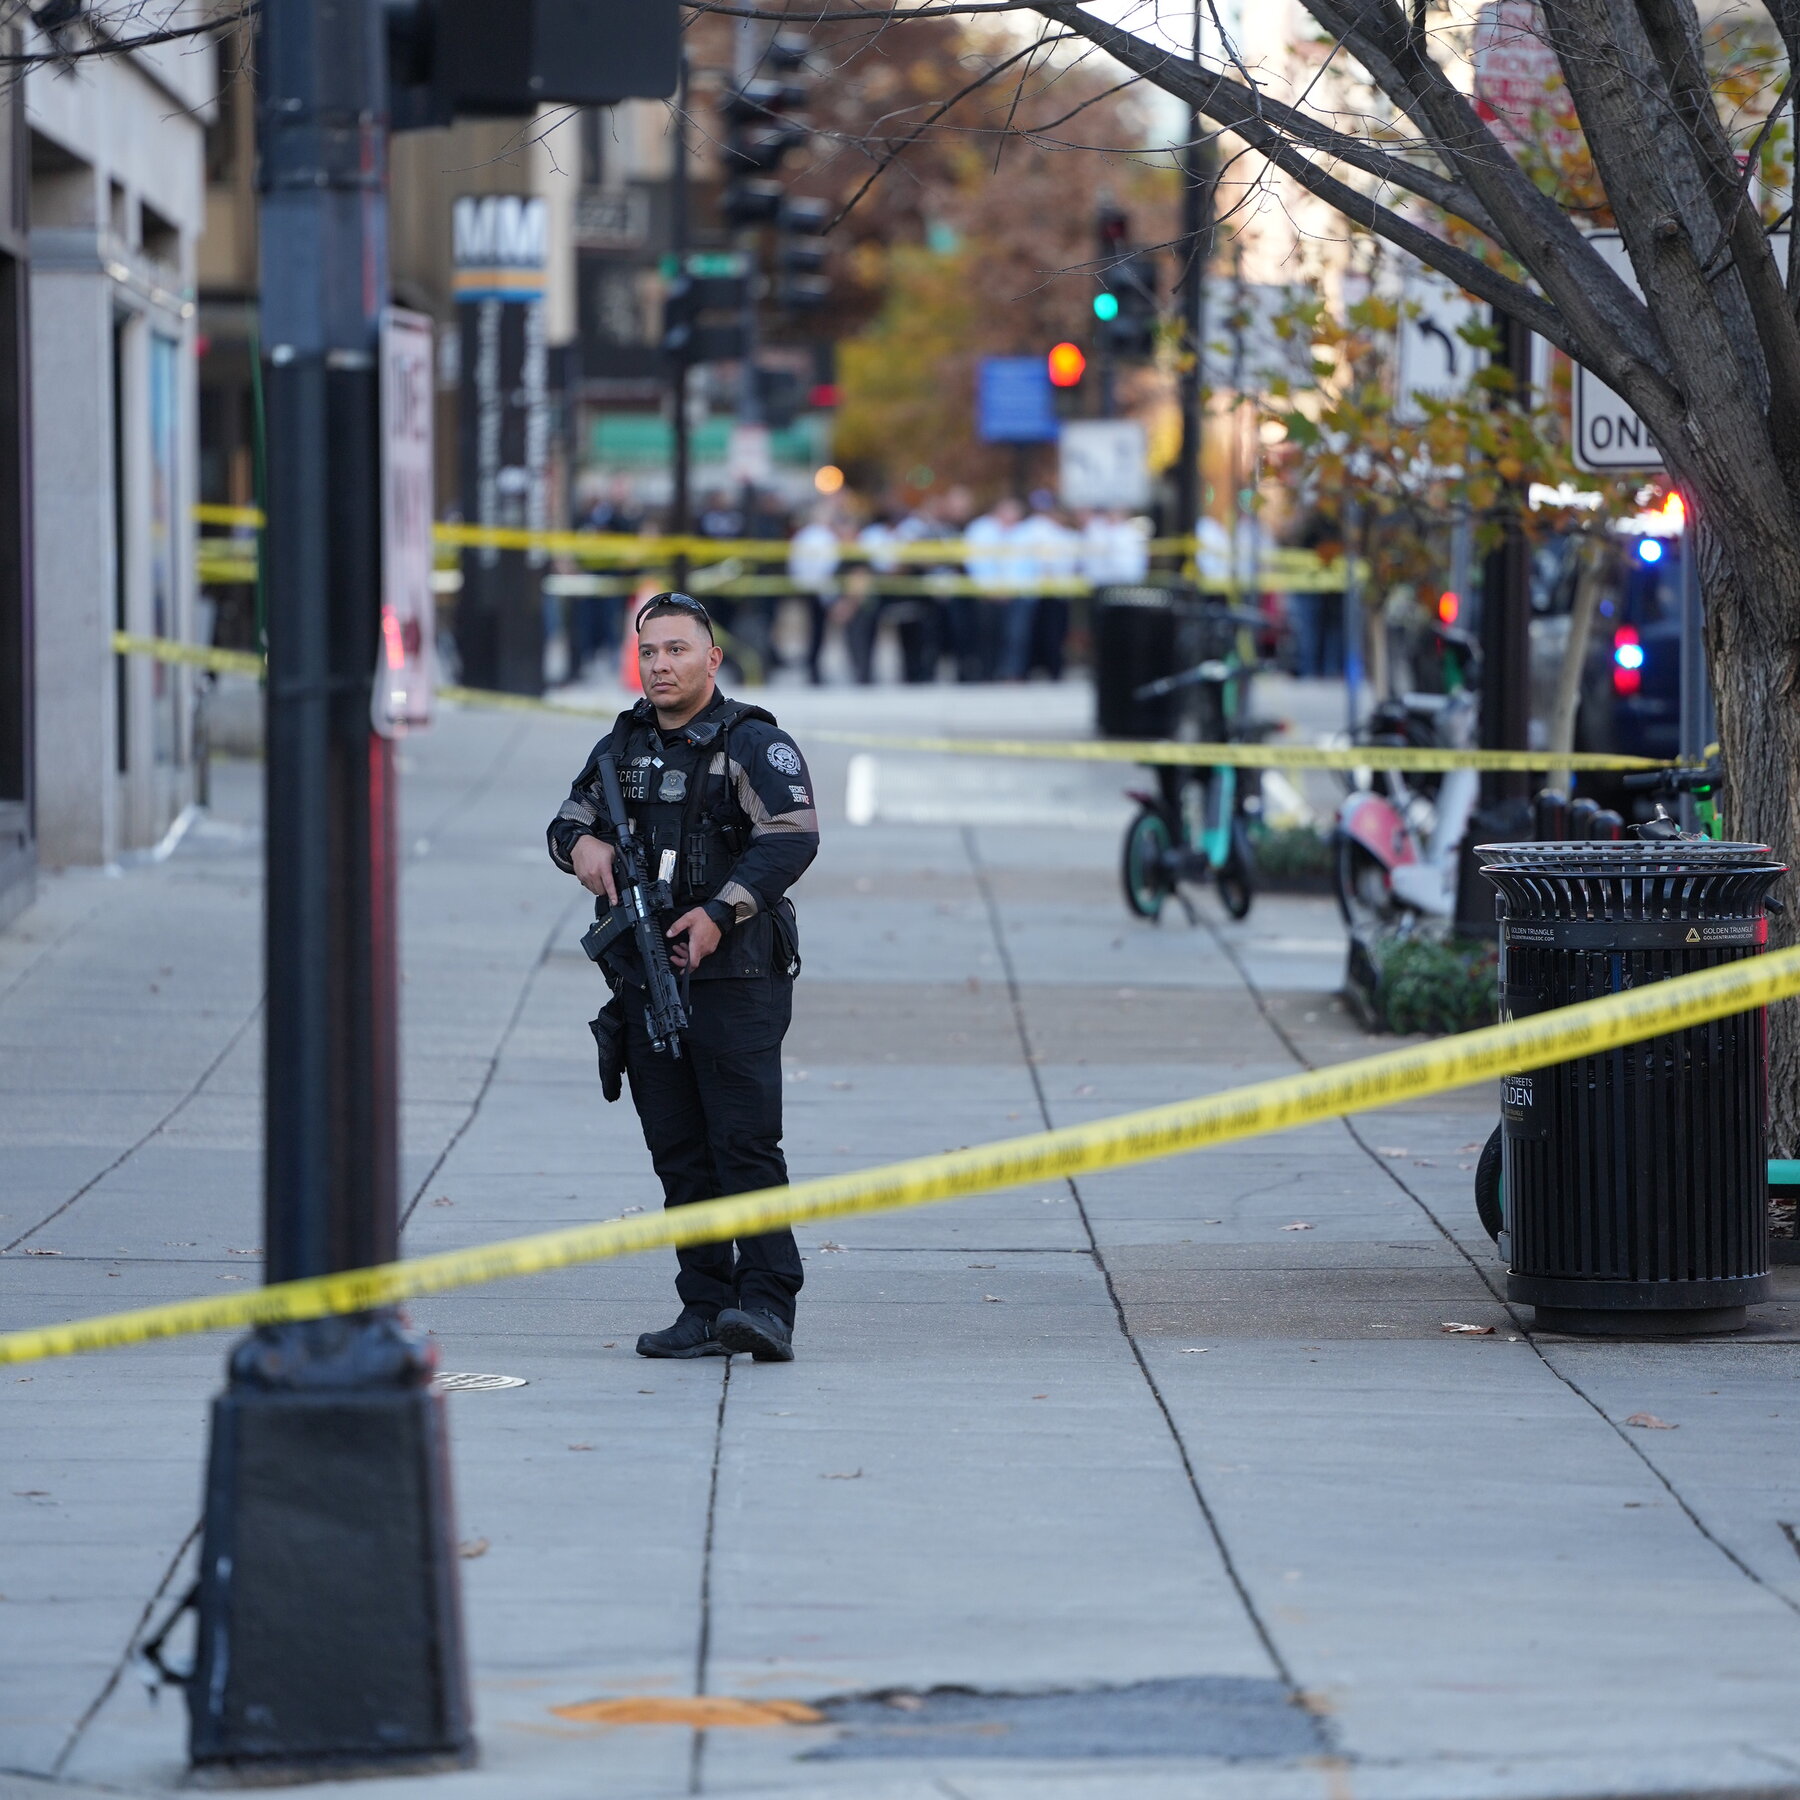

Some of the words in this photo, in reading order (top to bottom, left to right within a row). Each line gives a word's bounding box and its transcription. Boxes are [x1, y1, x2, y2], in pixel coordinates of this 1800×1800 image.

[618, 770, 645, 783] CRET
[622, 786, 645, 799] VICE
[1528, 928, 1555, 936] TRIANGLE
[1703, 926, 1729, 935] GOLDEN
[1730, 925, 1753, 933] TRIANGLE
[1511, 1076, 1533, 1087] STREETS
